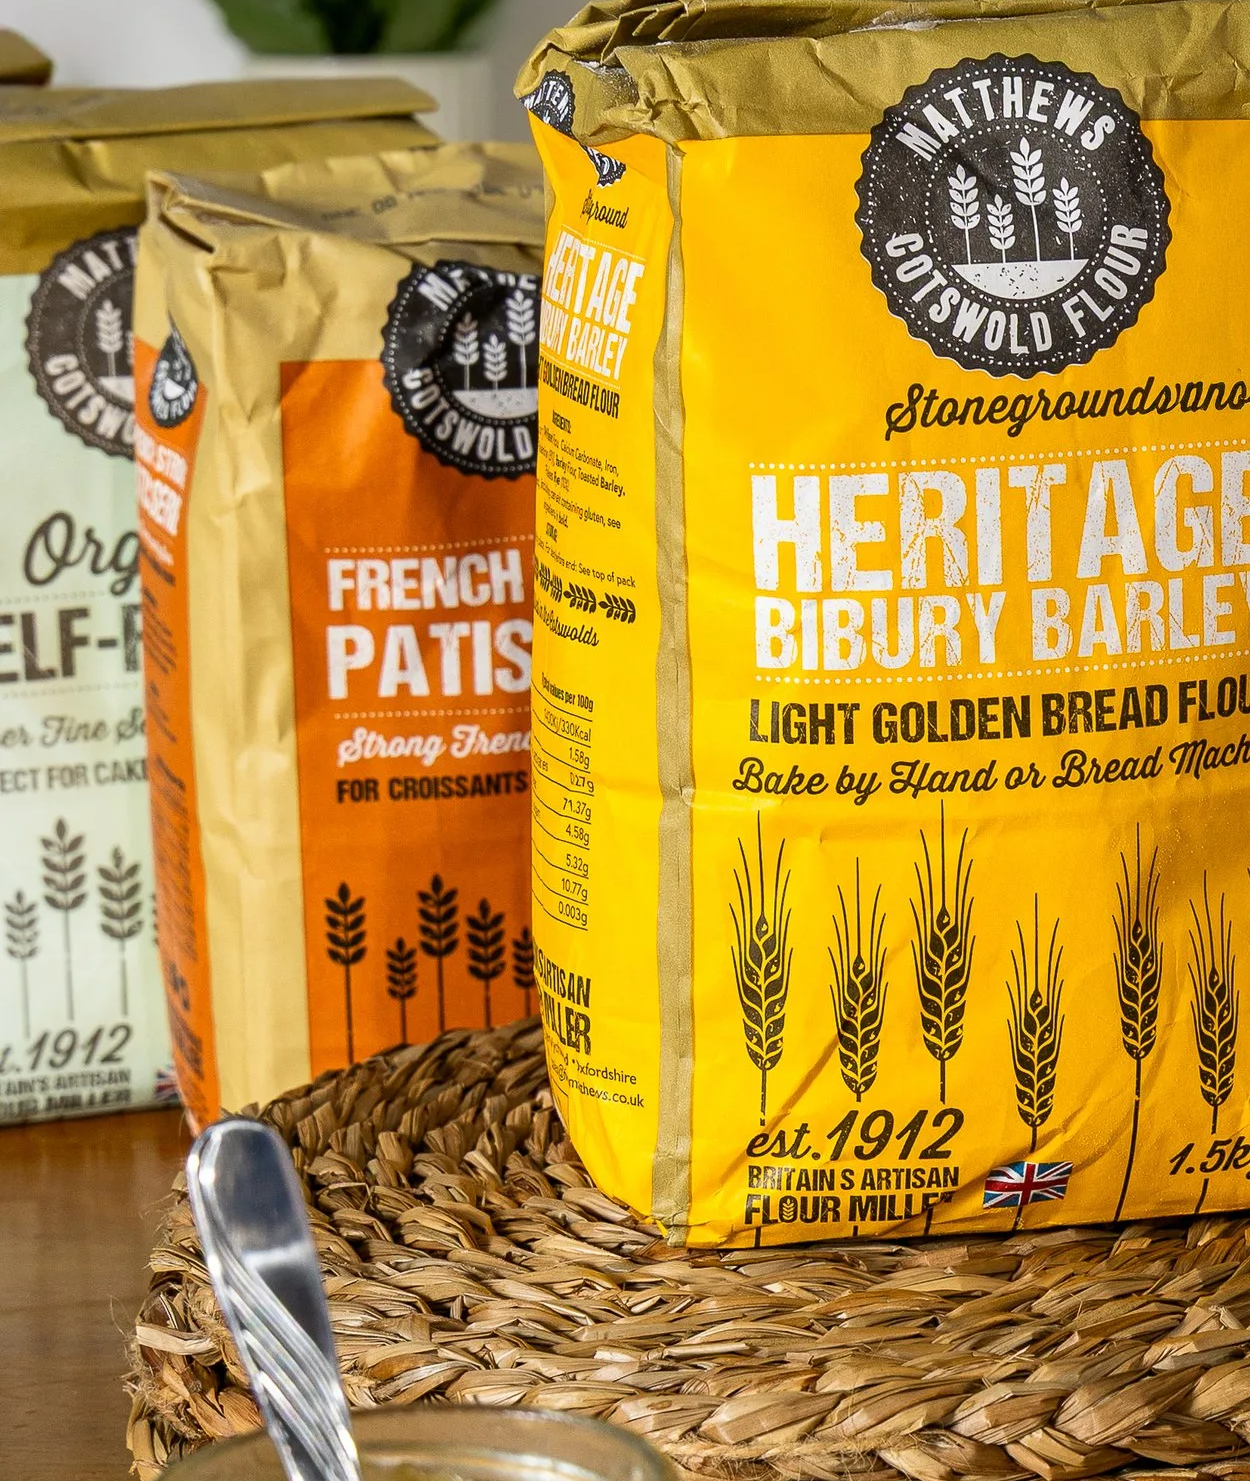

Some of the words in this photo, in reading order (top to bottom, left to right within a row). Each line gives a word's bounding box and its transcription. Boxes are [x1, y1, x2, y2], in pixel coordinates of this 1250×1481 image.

[895, 76, 1115, 161] MATTHEWS
[543, 229, 646, 335] HERTAGE
[885, 232, 1053, 355] COTSWOLD
[1062, 223, 1149, 339] FLOUR
[565, 316, 629, 382] BARLEY
[562, 370, 590, 409] BREAD
[589, 383, 621, 420] FLOUR
[402, 367, 533, 463] COTSWOLD
[604, 459, 620, 477] Iron,
[600, 476, 626, 497] Barley.
[607, 517, 621, 529] see
[327, 549, 525, 612] FRENCH
[578, 562, 591, 576] See
[592, 568, 606, 583] top
[606, 571, 615, 583] of
[616, 574, 636, 588] pack
[755, 590, 1007, 671] BIBURY
[326, 618, 533, 699] PATIS
[577, 693, 594, 713] 100g
[750, 698, 860, 745] LIGHT
[872, 694, 1031, 745] GOLDEN
[1041, 683, 1169, 737] BREAD
[336, 725, 446, 768] Strong
[569, 746, 590, 770] 1.58g
[47, 761, 90, 790] FOR
[337, 777, 380, 804] FOR
[388, 770, 530, 802] CROISSANTS
[732, 756, 829, 795] Bake
[835, 764, 882, 806] by
[888, 759, 998, 799] Hand
[1004, 762, 1047, 791] or
[1052, 746, 1164, 789] Bread
[565, 823, 590, 847] 4.58g
[565, 853, 589, 878] 5.32g
[561, 878, 588, 903] 10.77g
[558, 900, 588, 927] 0.003g
[860, 1166, 960, 1192] ARTISAN
[744, 1193, 842, 1225] FLOUR
